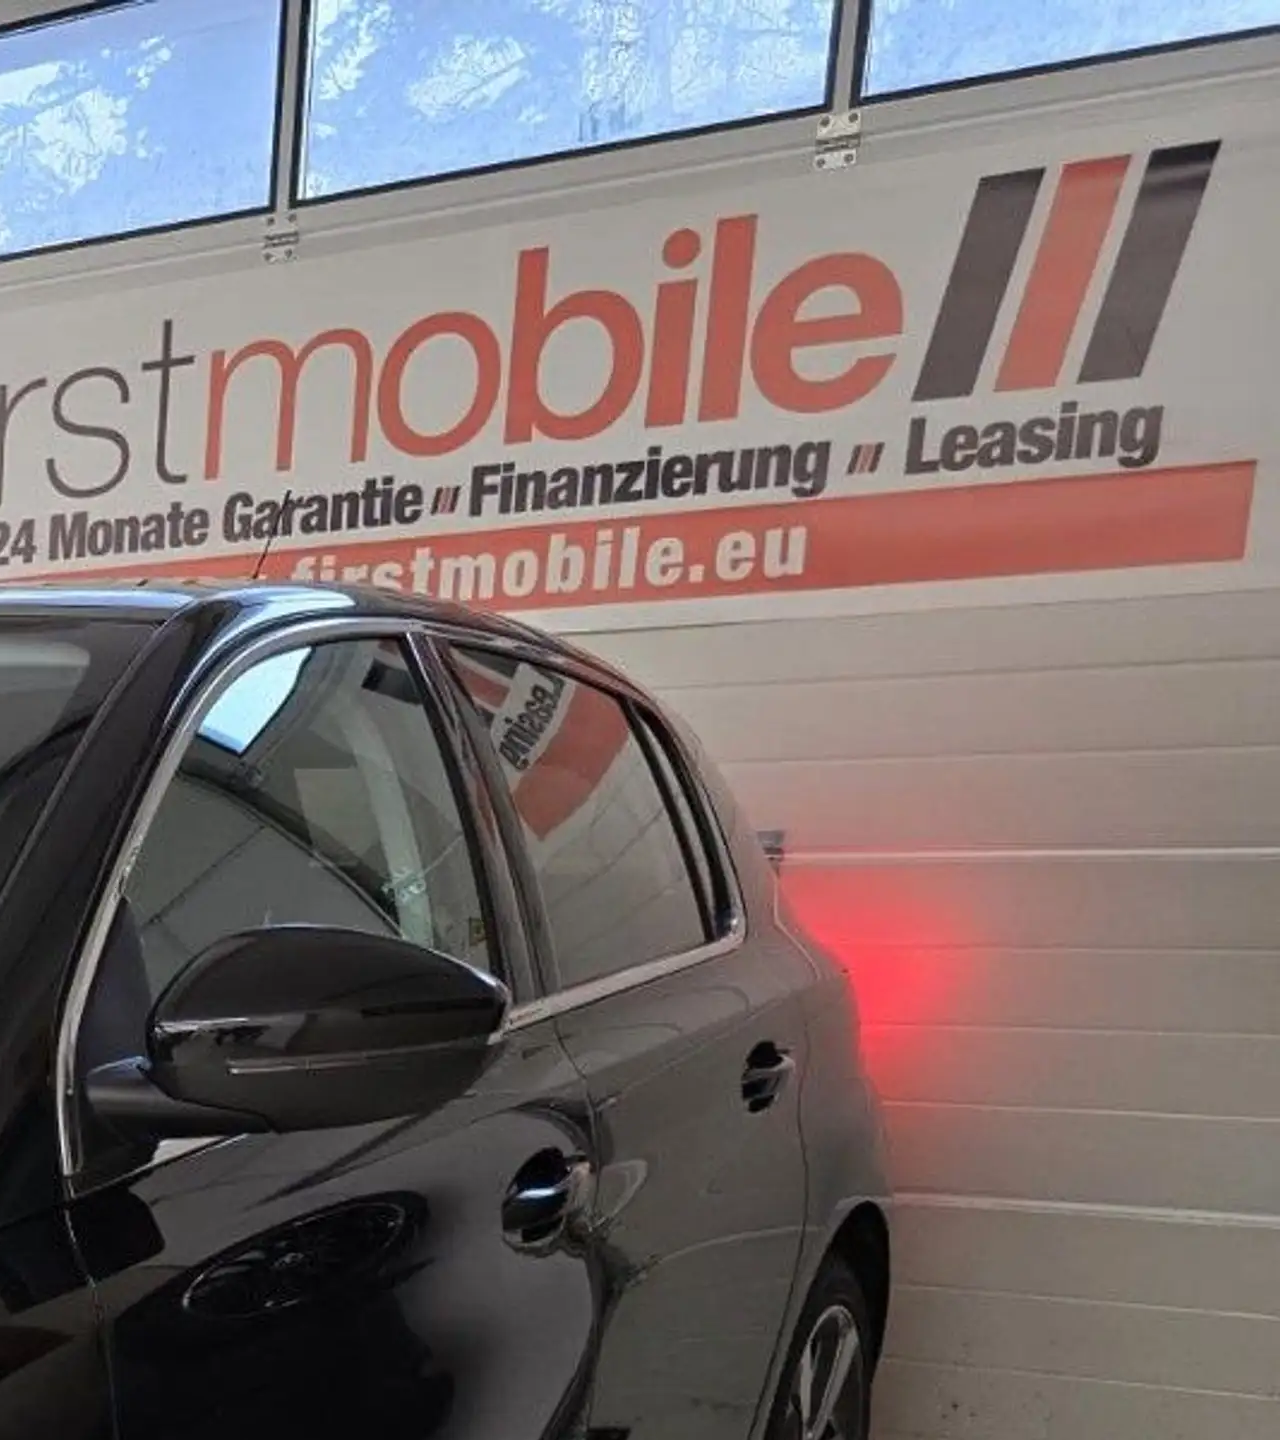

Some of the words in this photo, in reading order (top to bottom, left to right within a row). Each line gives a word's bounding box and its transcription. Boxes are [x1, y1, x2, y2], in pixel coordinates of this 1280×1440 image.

[47, 499, 211, 562] Monate
[222, 474, 425, 543] Garantie
[468, 439, 832, 517] Finanzierung
[904, 400, 1164, 475] Leasing
